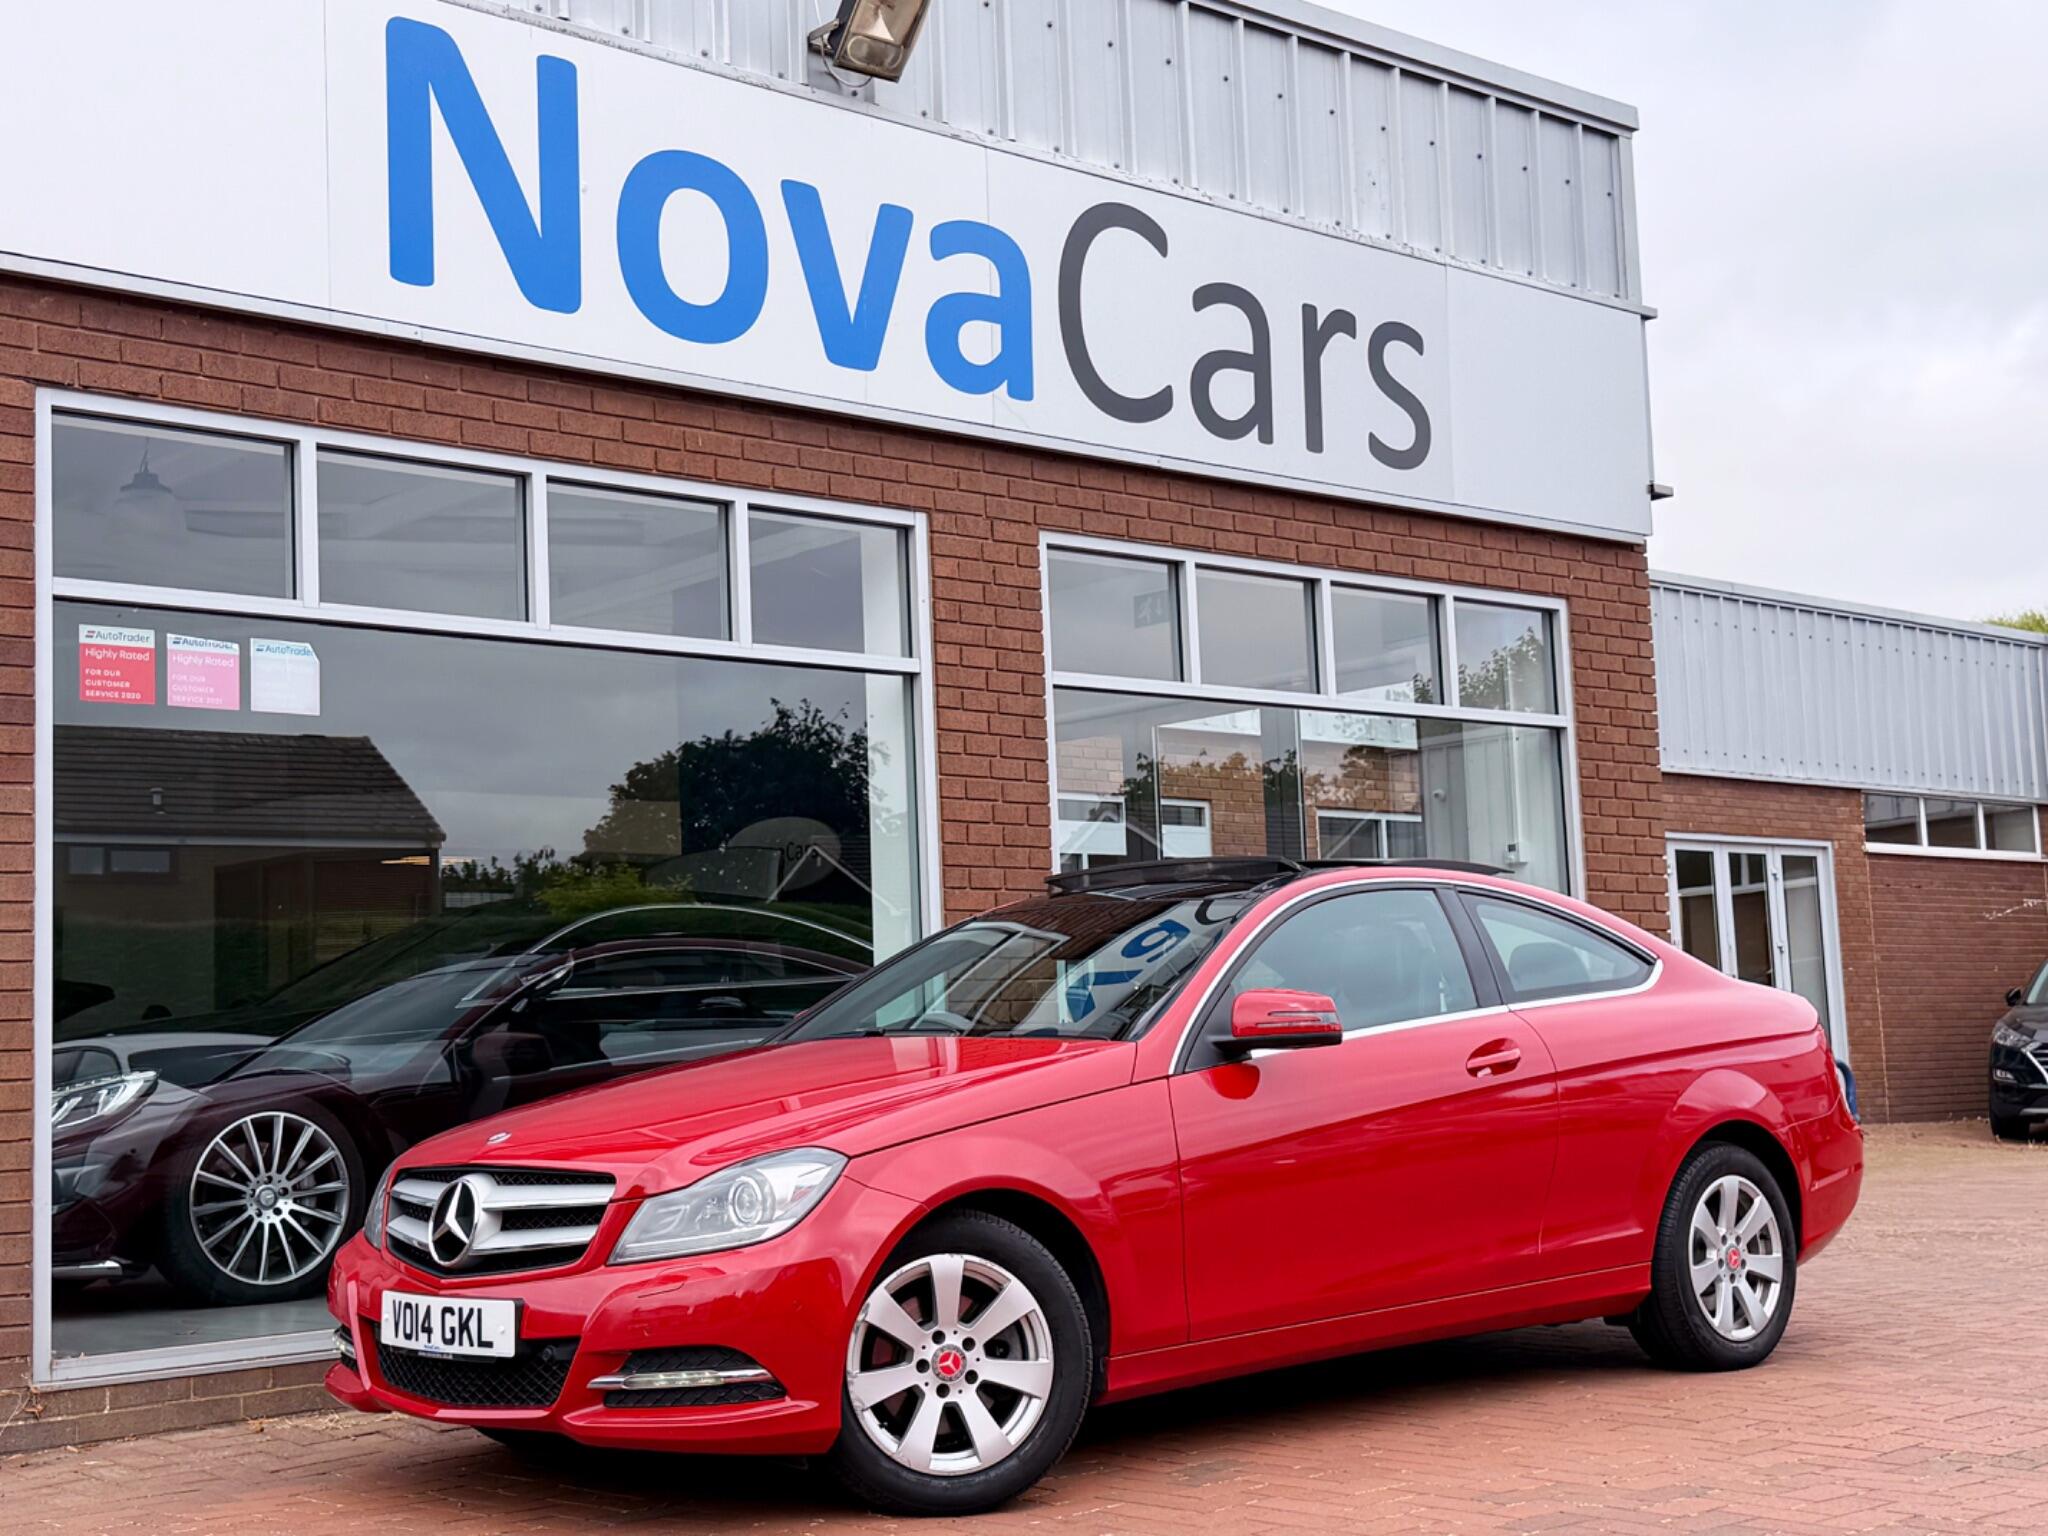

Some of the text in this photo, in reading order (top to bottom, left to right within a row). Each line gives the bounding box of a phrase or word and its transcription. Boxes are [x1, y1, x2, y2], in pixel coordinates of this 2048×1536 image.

[385, 16, 1431, 470] NovaCars
[96, 631, 150, 642] AutoTrader
[85, 648, 150, 661] Highly Rated
[172, 655, 234, 667] Highly Rated
[103, 669, 121, 677] OUR
[85, 679, 130, 688] CUSTOMER
[85, 690, 119, 698] SERVICE
[441, 1306, 494, 1349] GKL
